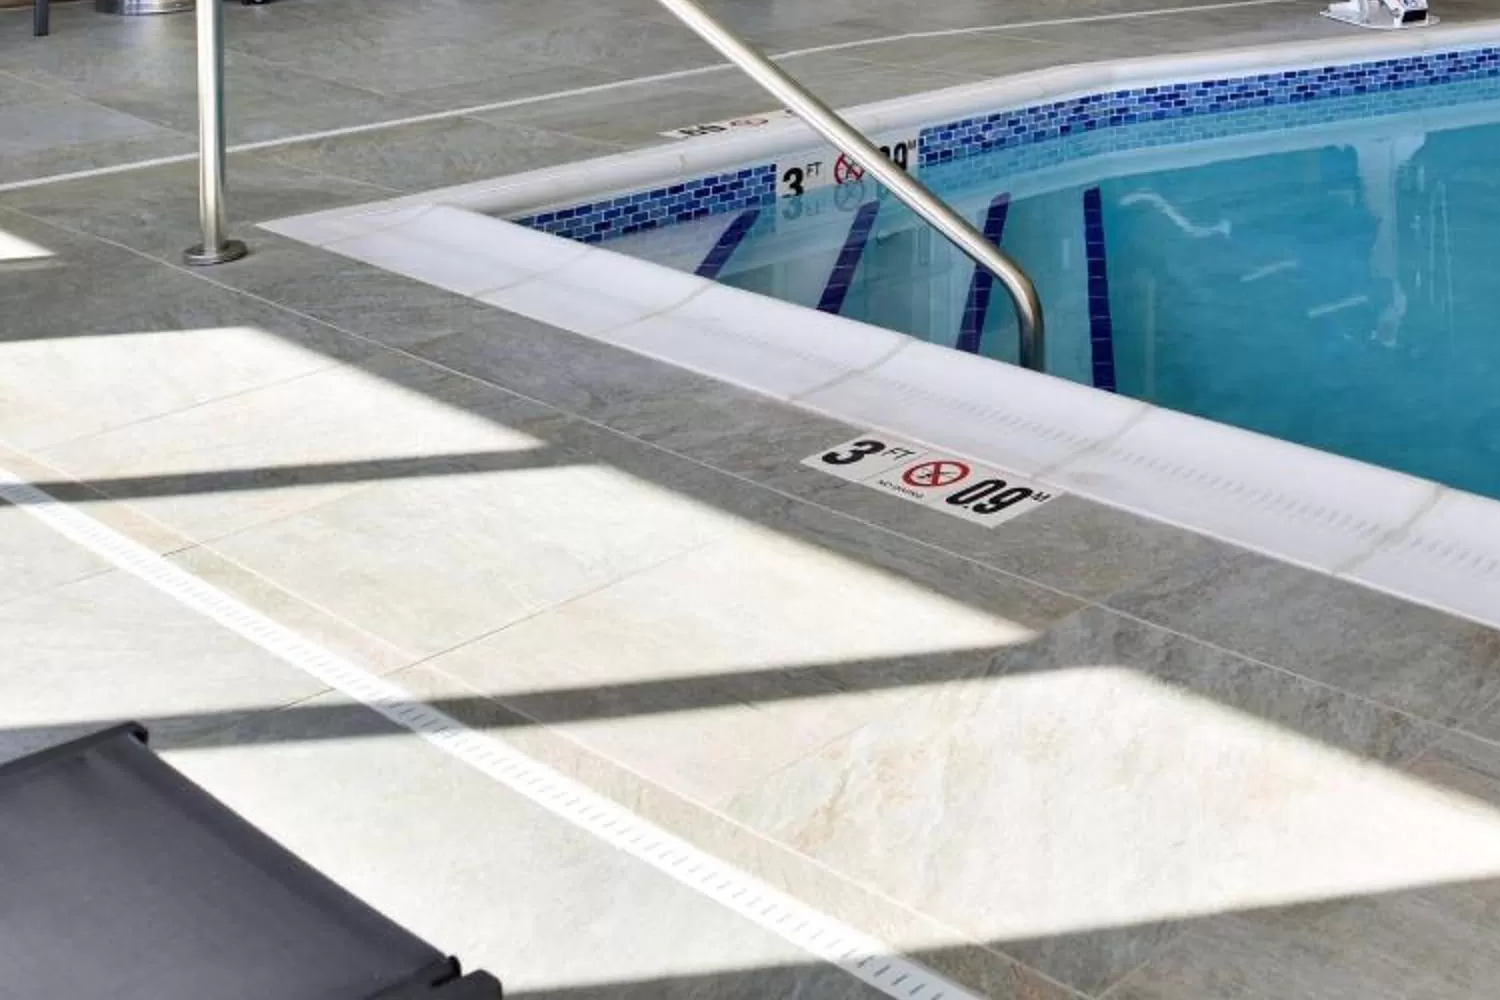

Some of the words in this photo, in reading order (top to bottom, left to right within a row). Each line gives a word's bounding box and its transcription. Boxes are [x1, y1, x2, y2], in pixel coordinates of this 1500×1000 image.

[782, 166, 804, 199] 3
[807, 161, 822, 177] FT
[822, 440, 885, 466] 3
[882, 446, 916, 460] FT
[945, 478, 1033, 514] 0.9
[1033, 490, 1052, 503] M
